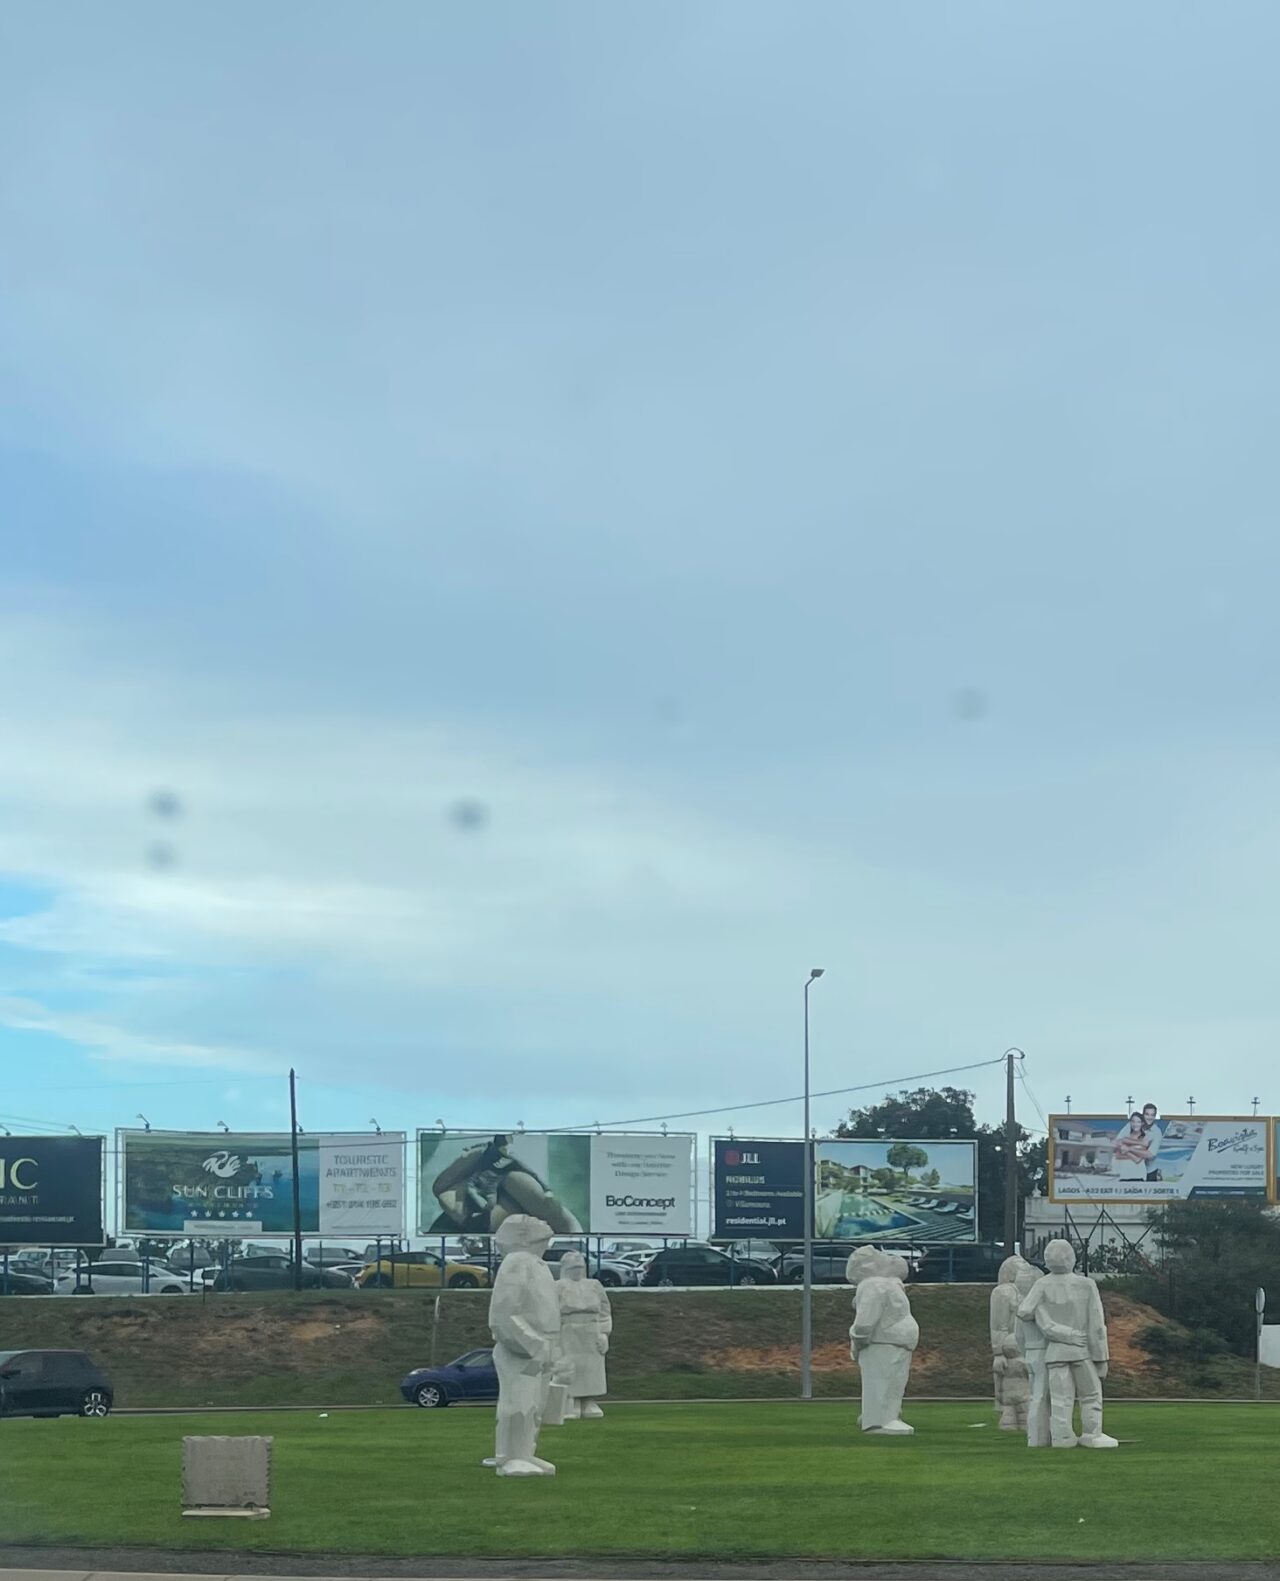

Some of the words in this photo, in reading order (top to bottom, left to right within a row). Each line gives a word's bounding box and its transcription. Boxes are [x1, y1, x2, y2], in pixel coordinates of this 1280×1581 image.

[741, 1153, 761, 1164] JLL
[327, 1168, 397, 1178] APARTMENTS
[173, 1185, 208, 1198] SUN
[214, 1186, 274, 1199] CLIFFS
[605, 1195, 676, 1210] BoConcept
